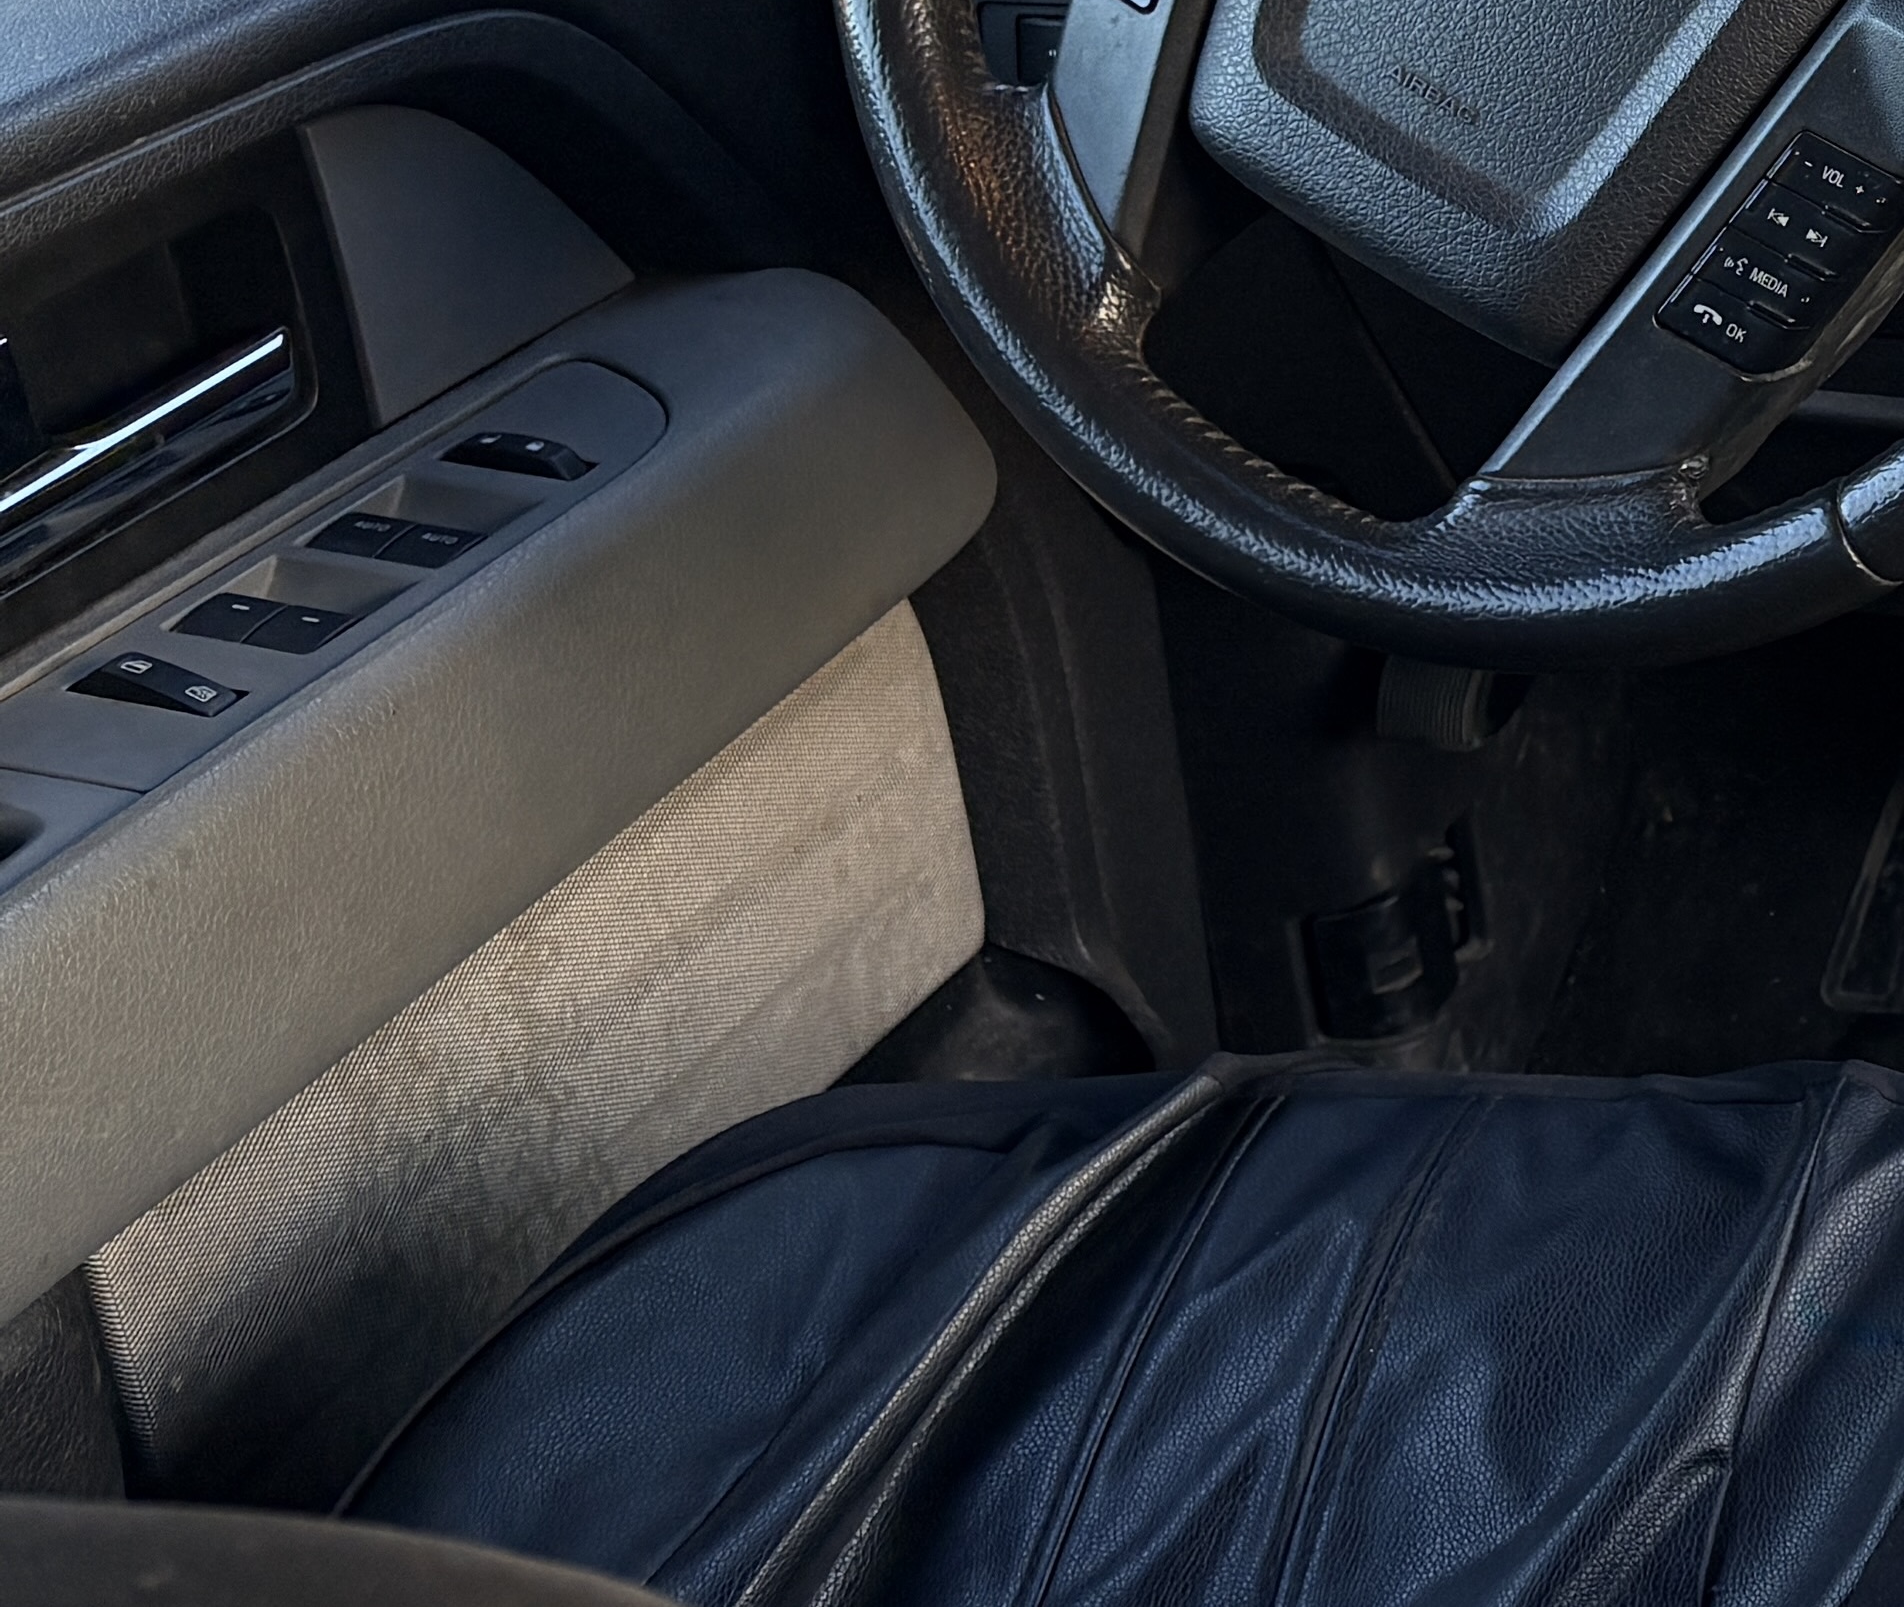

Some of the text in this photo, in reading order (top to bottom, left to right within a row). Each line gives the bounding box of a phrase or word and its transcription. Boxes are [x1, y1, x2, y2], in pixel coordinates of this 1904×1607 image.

[1387, 64, 1474, 123] AIRBAG
[1821, 165, 1844, 188] VOL
[1749, 267, 1789, 298] MEDIA
[1725, 323, 1748, 343] OK
